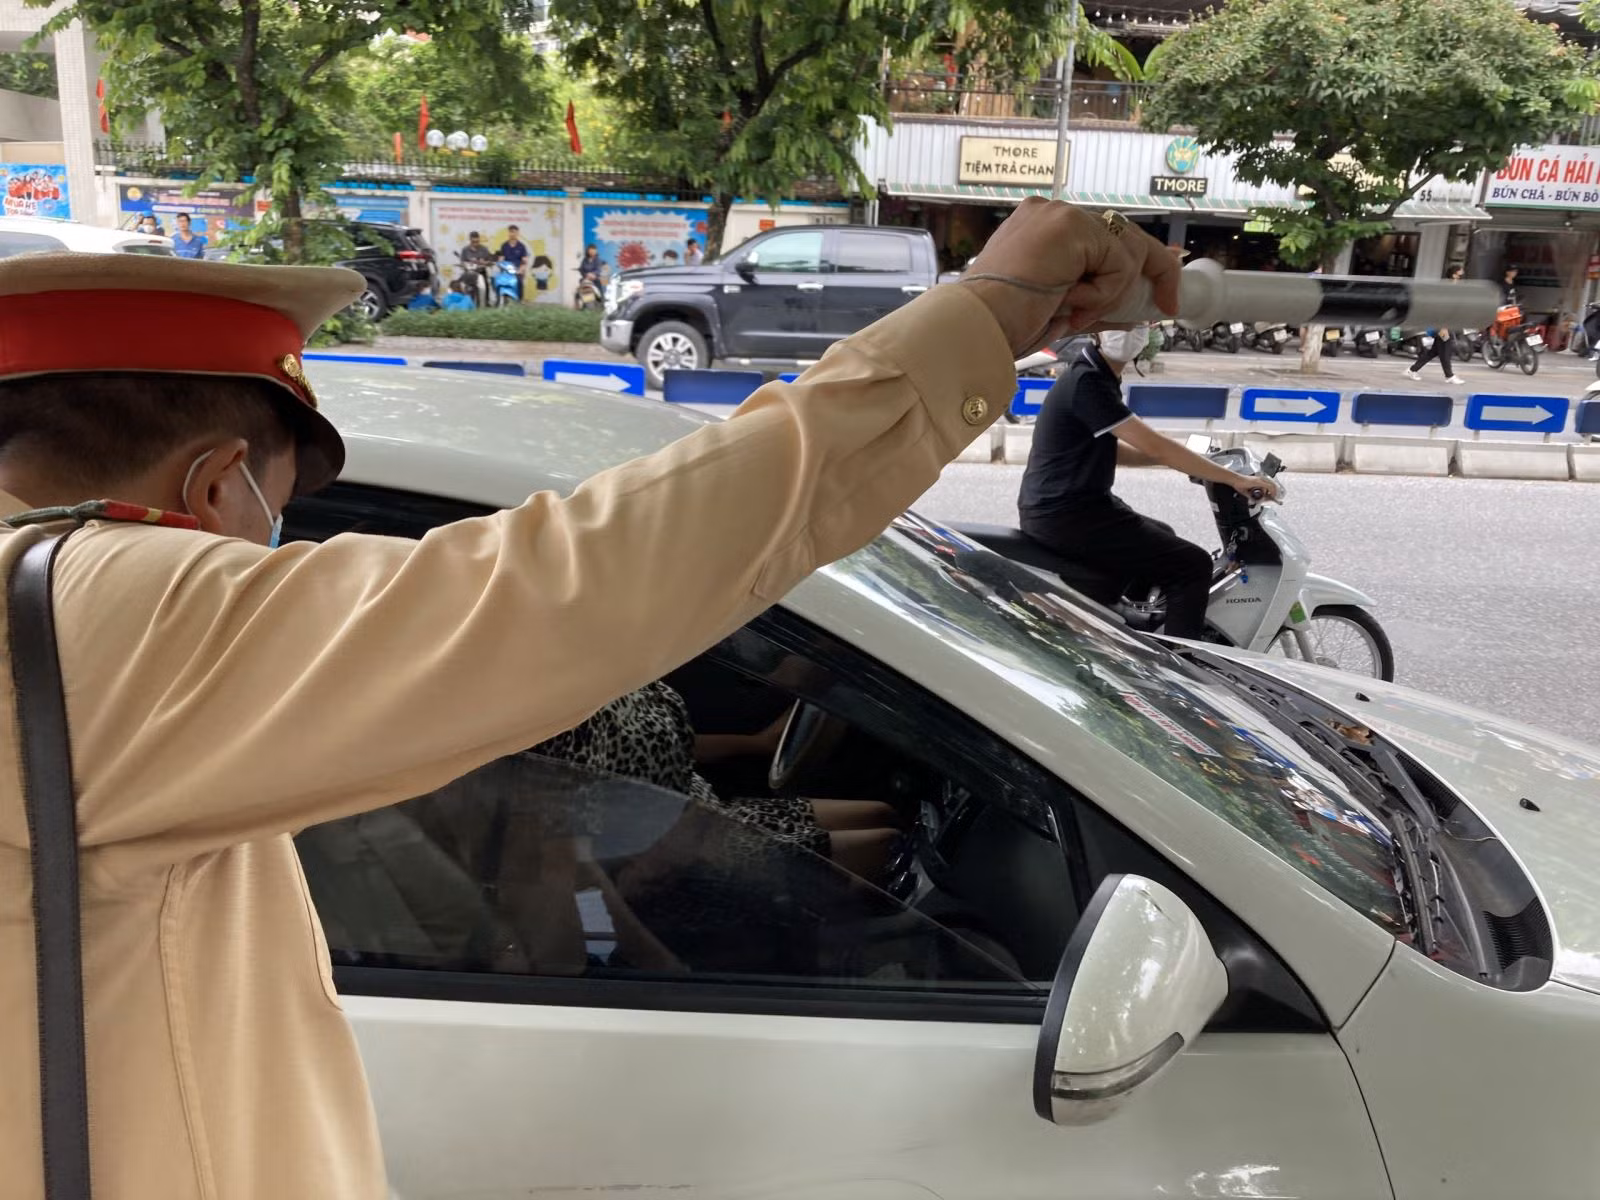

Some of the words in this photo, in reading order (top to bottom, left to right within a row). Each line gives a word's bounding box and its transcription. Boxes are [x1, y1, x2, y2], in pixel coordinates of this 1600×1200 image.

[993, 146, 1039, 158] TMORE
[965, 160, 992, 176] TIỆM
[1019, 164, 1054, 175] CHAN
[1537, 154, 1561, 182] CÁ
[1563, 153, 1594, 184] HẢI
[1154, 178, 1206, 193] TMORE
[1492, 185, 1519, 199] BÚN
[1521, 185, 1545, 200] CHẢ
[1555, 187, 1580, 201] BÚN
[1420, 190, 1432, 202] 55
